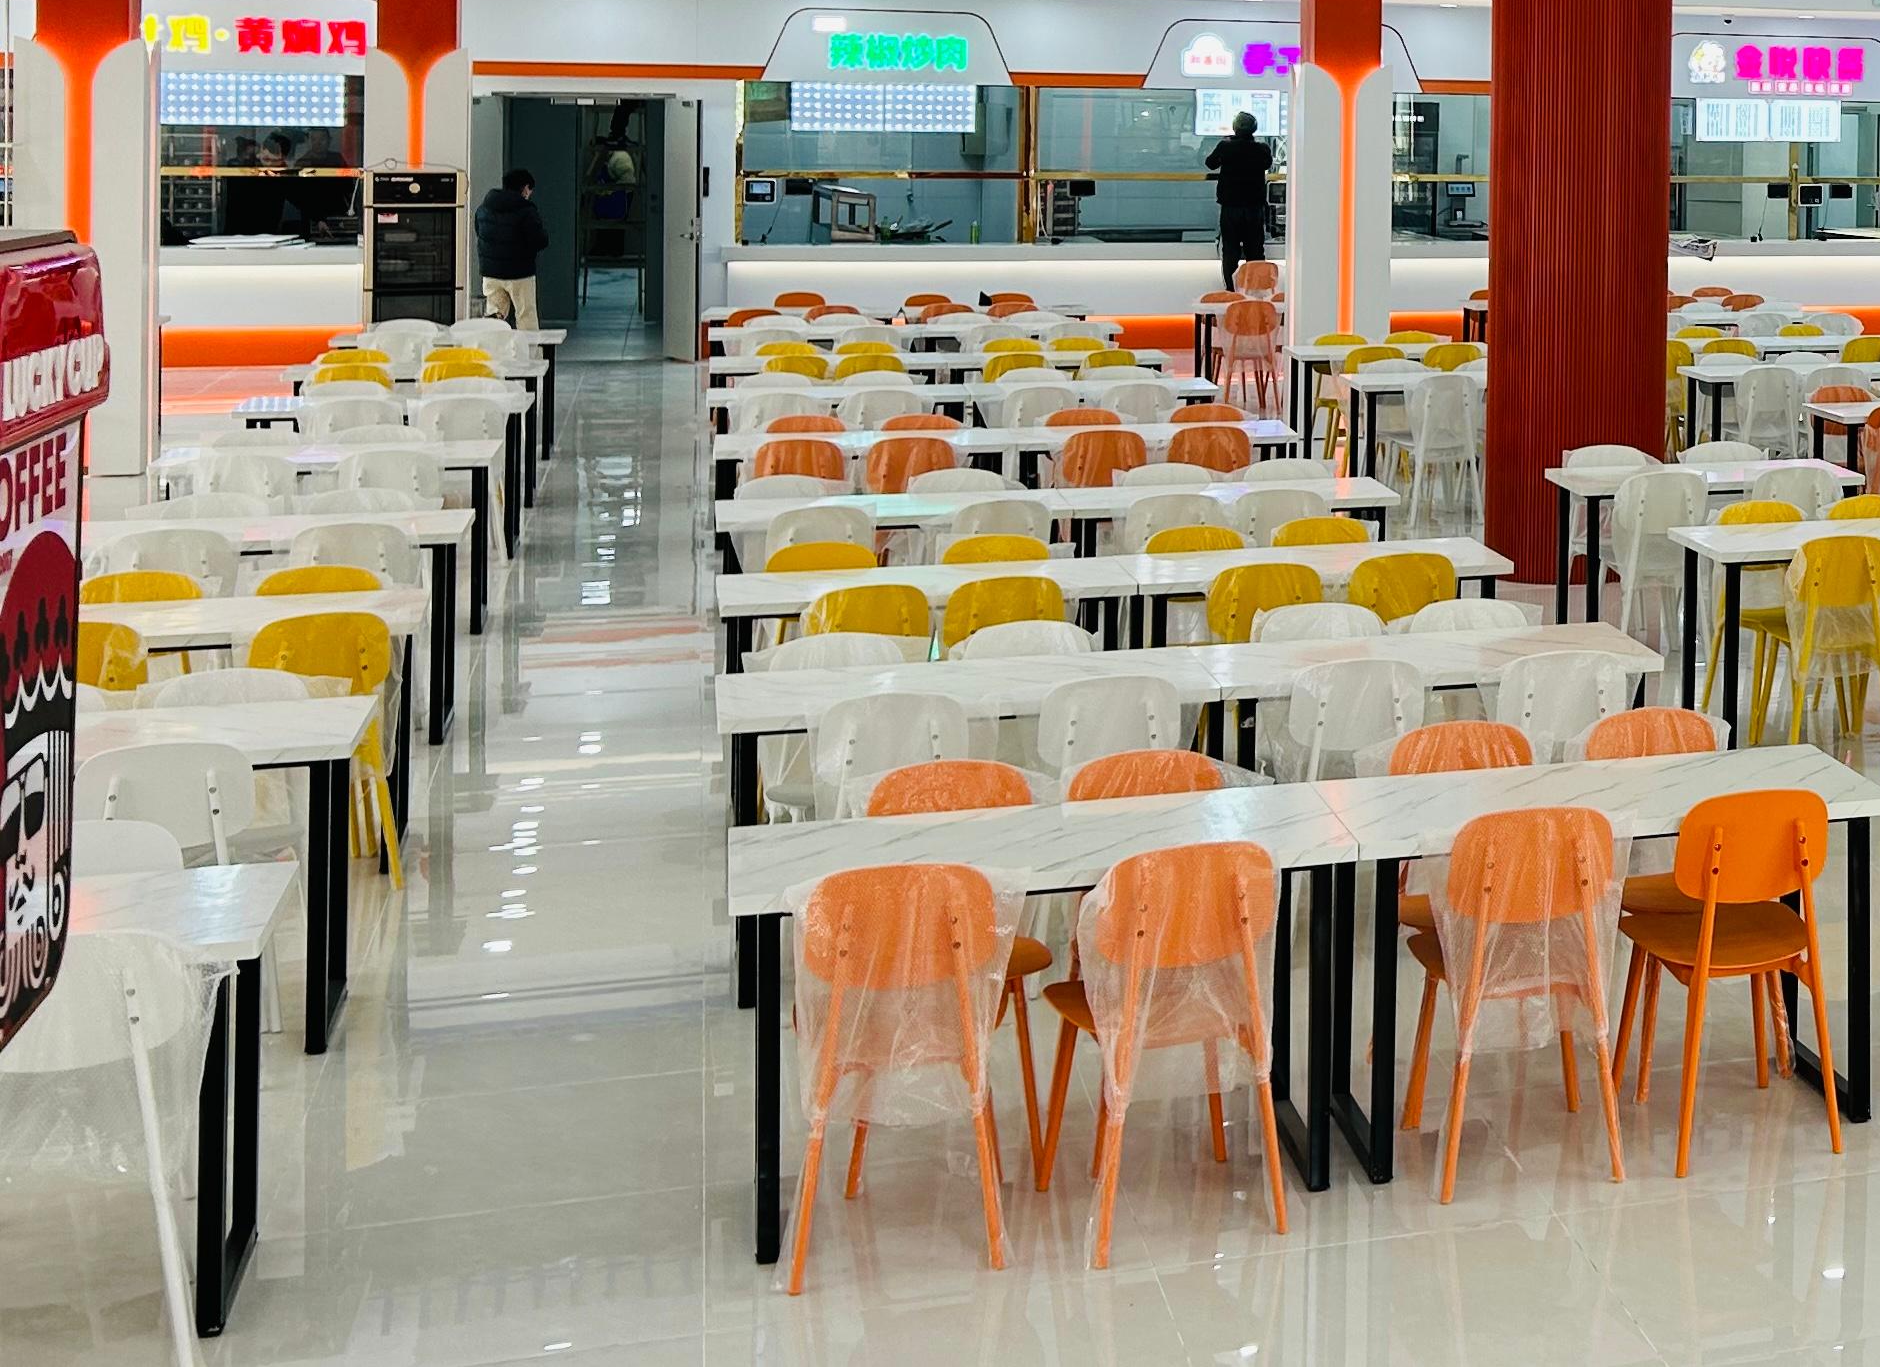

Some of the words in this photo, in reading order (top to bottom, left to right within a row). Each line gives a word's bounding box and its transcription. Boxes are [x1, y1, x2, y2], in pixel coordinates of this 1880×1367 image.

[828, 33, 969, 72] 辣椒炒肉
[2, 344, 67, 422] LUCKY
[66, 333, 105, 396] CUP
